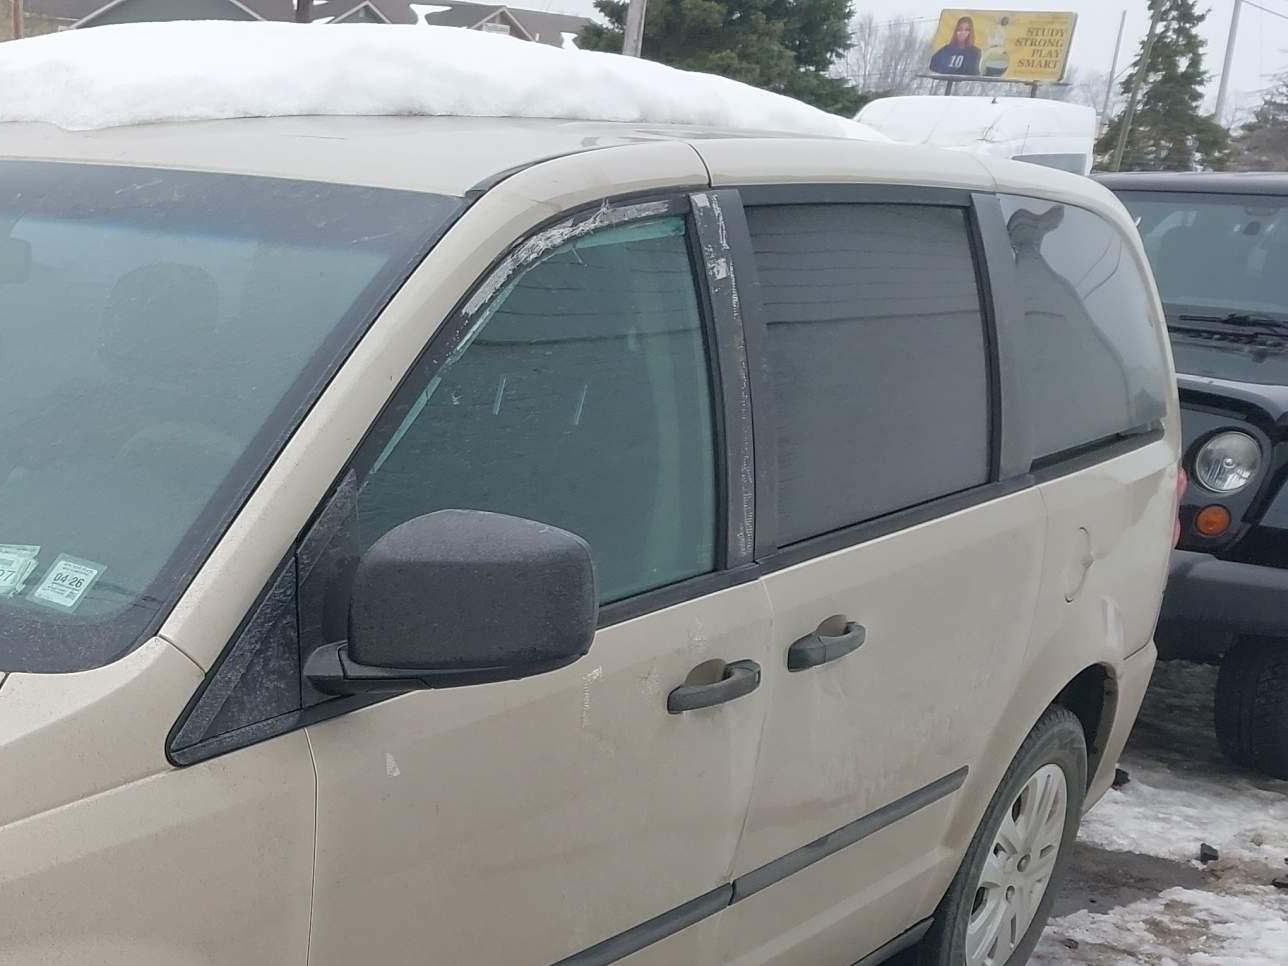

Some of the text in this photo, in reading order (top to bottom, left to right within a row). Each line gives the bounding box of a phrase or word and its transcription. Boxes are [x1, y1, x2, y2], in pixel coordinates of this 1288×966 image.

[1026, 27, 1064, 37] STUDY
[1015, 38, 1064, 48] STRONG
[1031, 49, 1060, 58] PLAY
[948, 55, 964, 68] 10
[1017, 60, 1058, 69] SMART
